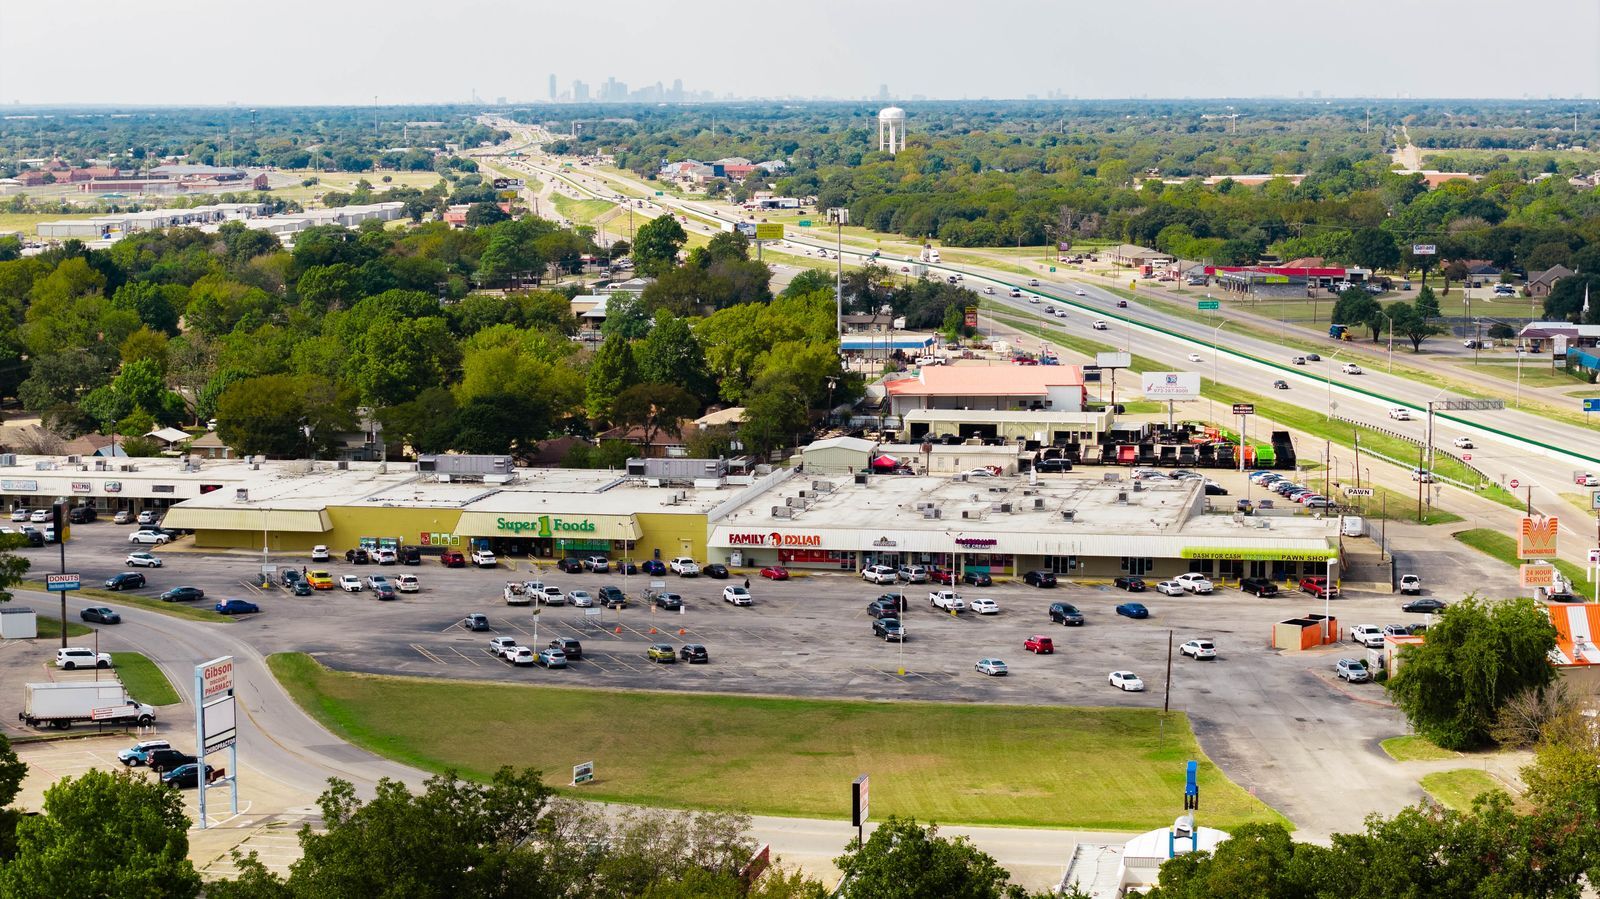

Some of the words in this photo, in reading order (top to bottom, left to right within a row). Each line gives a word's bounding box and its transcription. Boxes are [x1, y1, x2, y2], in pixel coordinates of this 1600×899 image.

[497, 518, 537, 534] Super
[538, 515, 553, 537] 1
[554, 518, 595, 532] Foods
[729, 534, 765, 544] FAMILY
[785, 535, 821, 546] DOLLAR
[204, 664, 232, 680] Gibson
[205, 680, 232, 696] PHARMACY
[209, 675, 228, 686] DISCOUNT
[205, 738, 236, 755] CHIROPRACTOR
